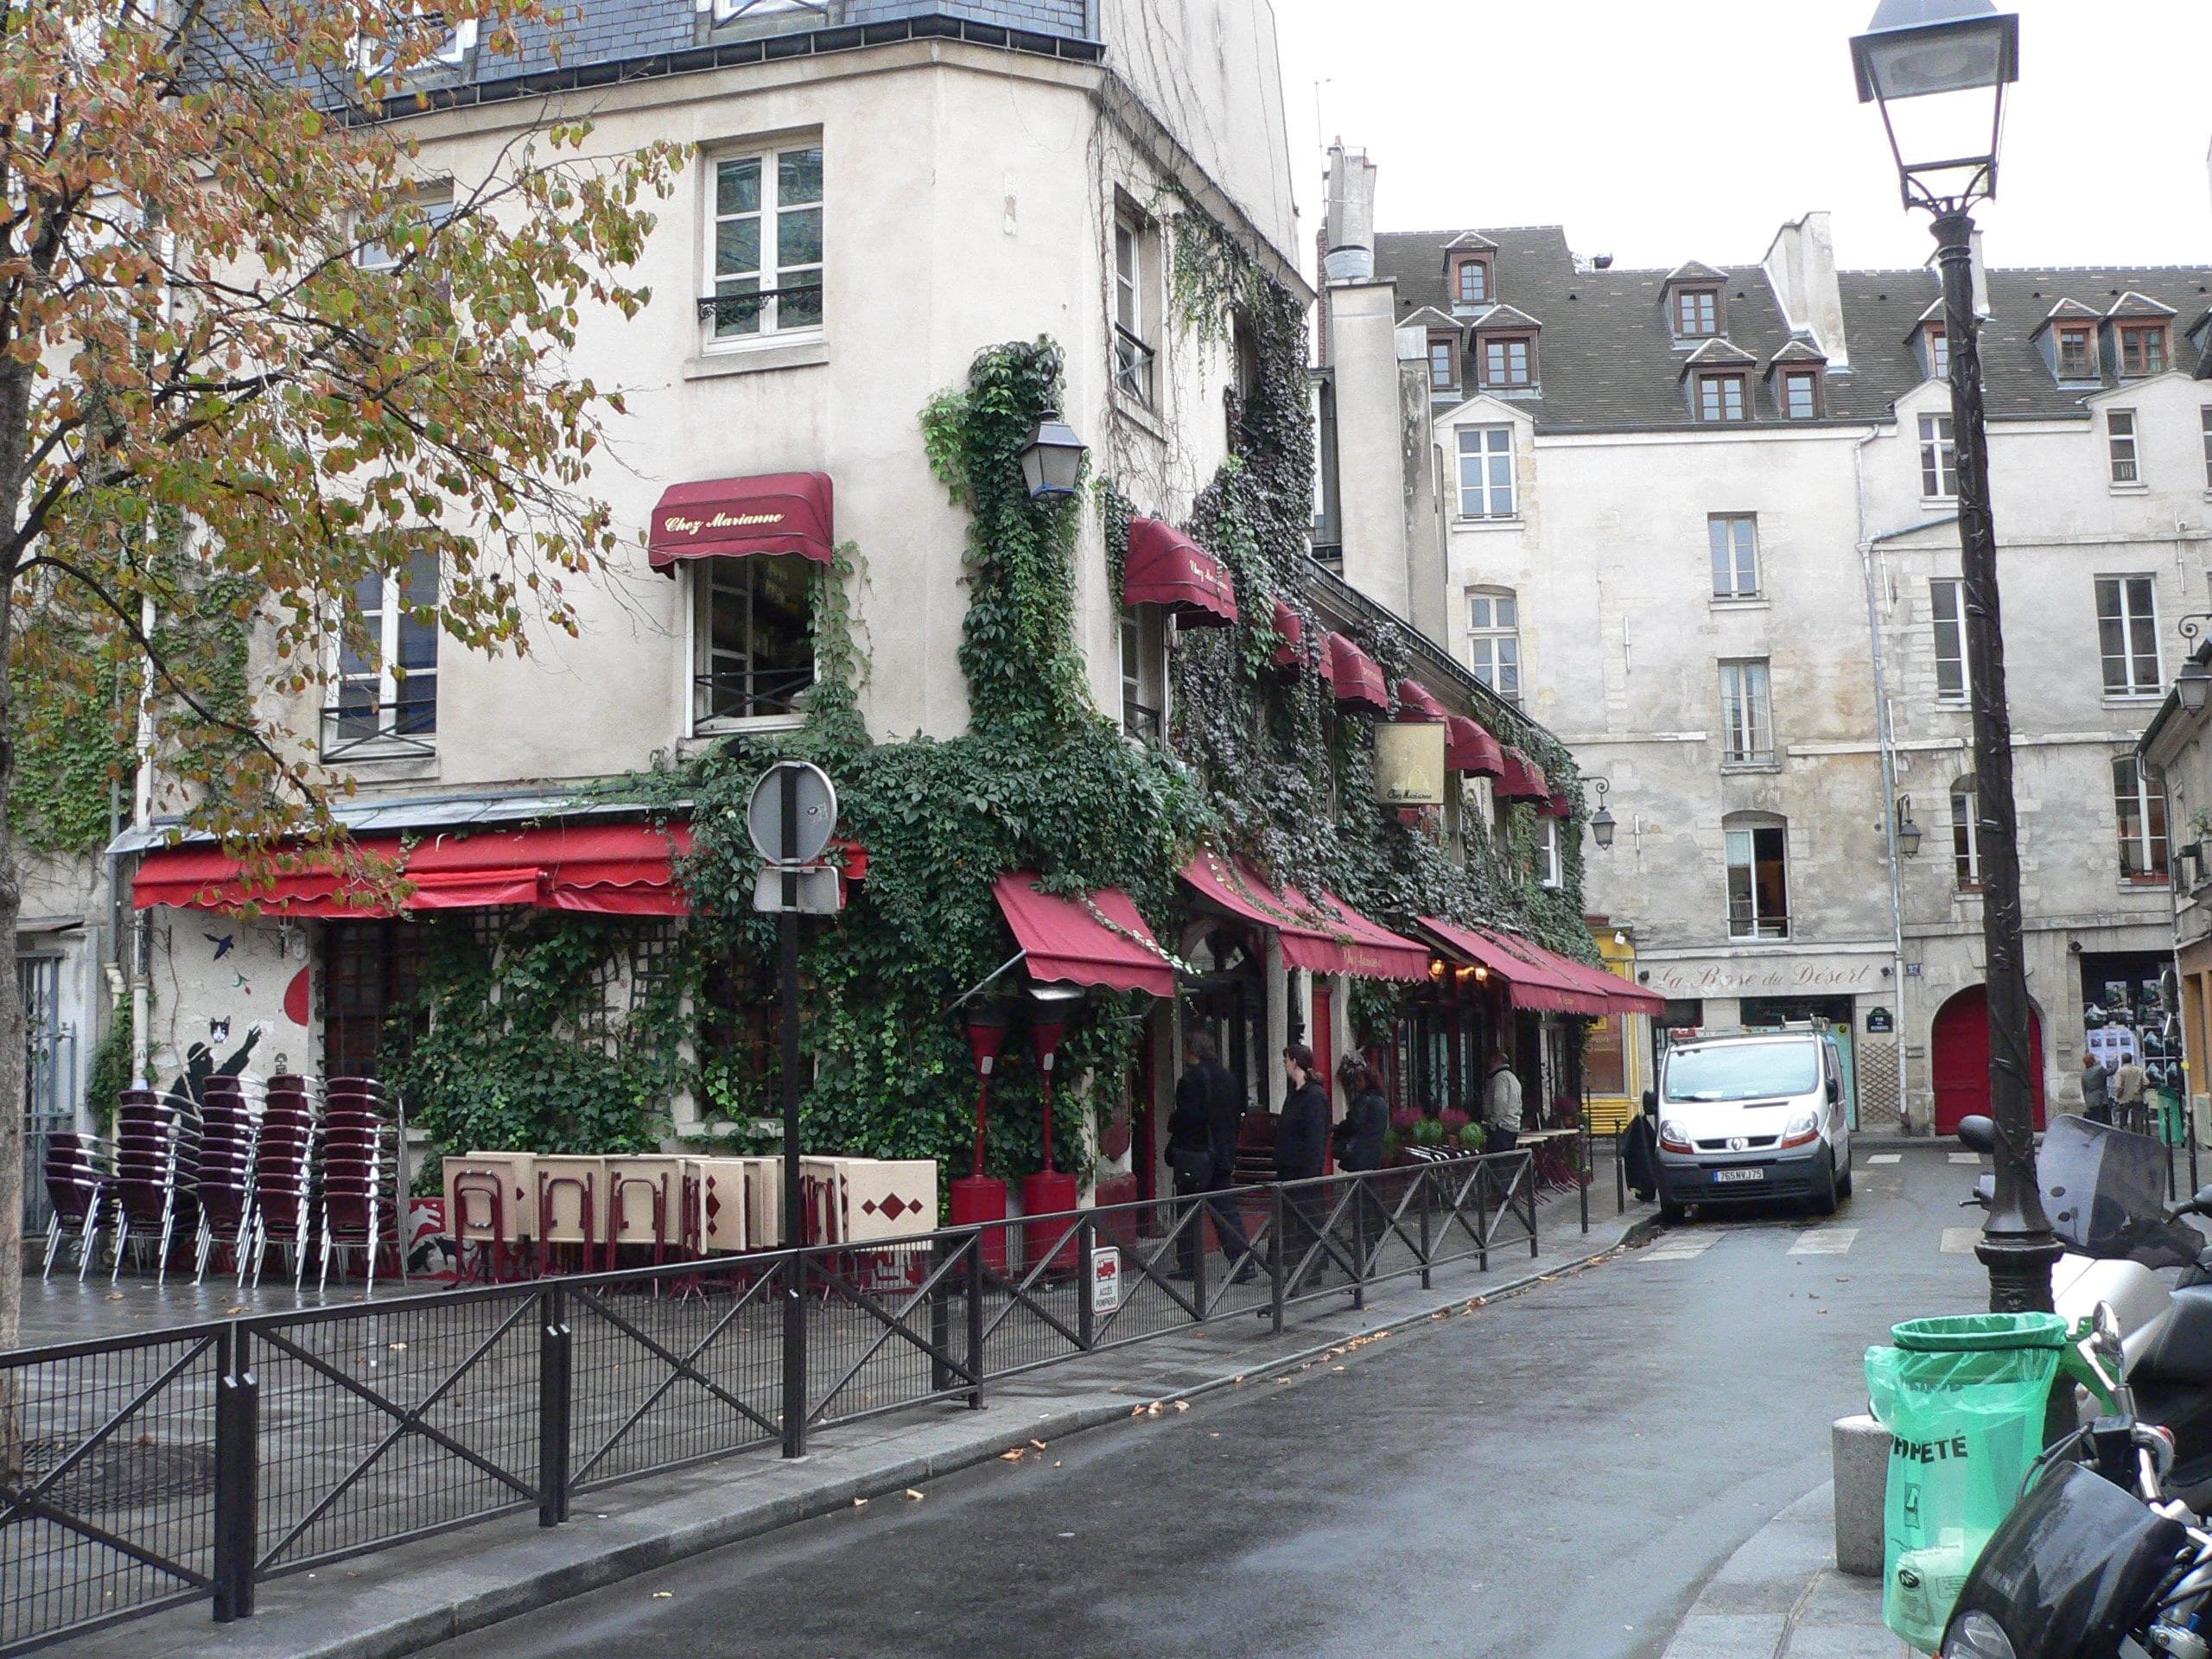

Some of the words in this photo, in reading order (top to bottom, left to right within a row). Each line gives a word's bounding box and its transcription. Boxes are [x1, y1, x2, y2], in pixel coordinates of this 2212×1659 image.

[664, 517, 704, 536] Chez
[705, 512, 785, 528] Marianne
[1763, 971, 1783, 986] du
[1792, 962, 1871, 986] Désert
